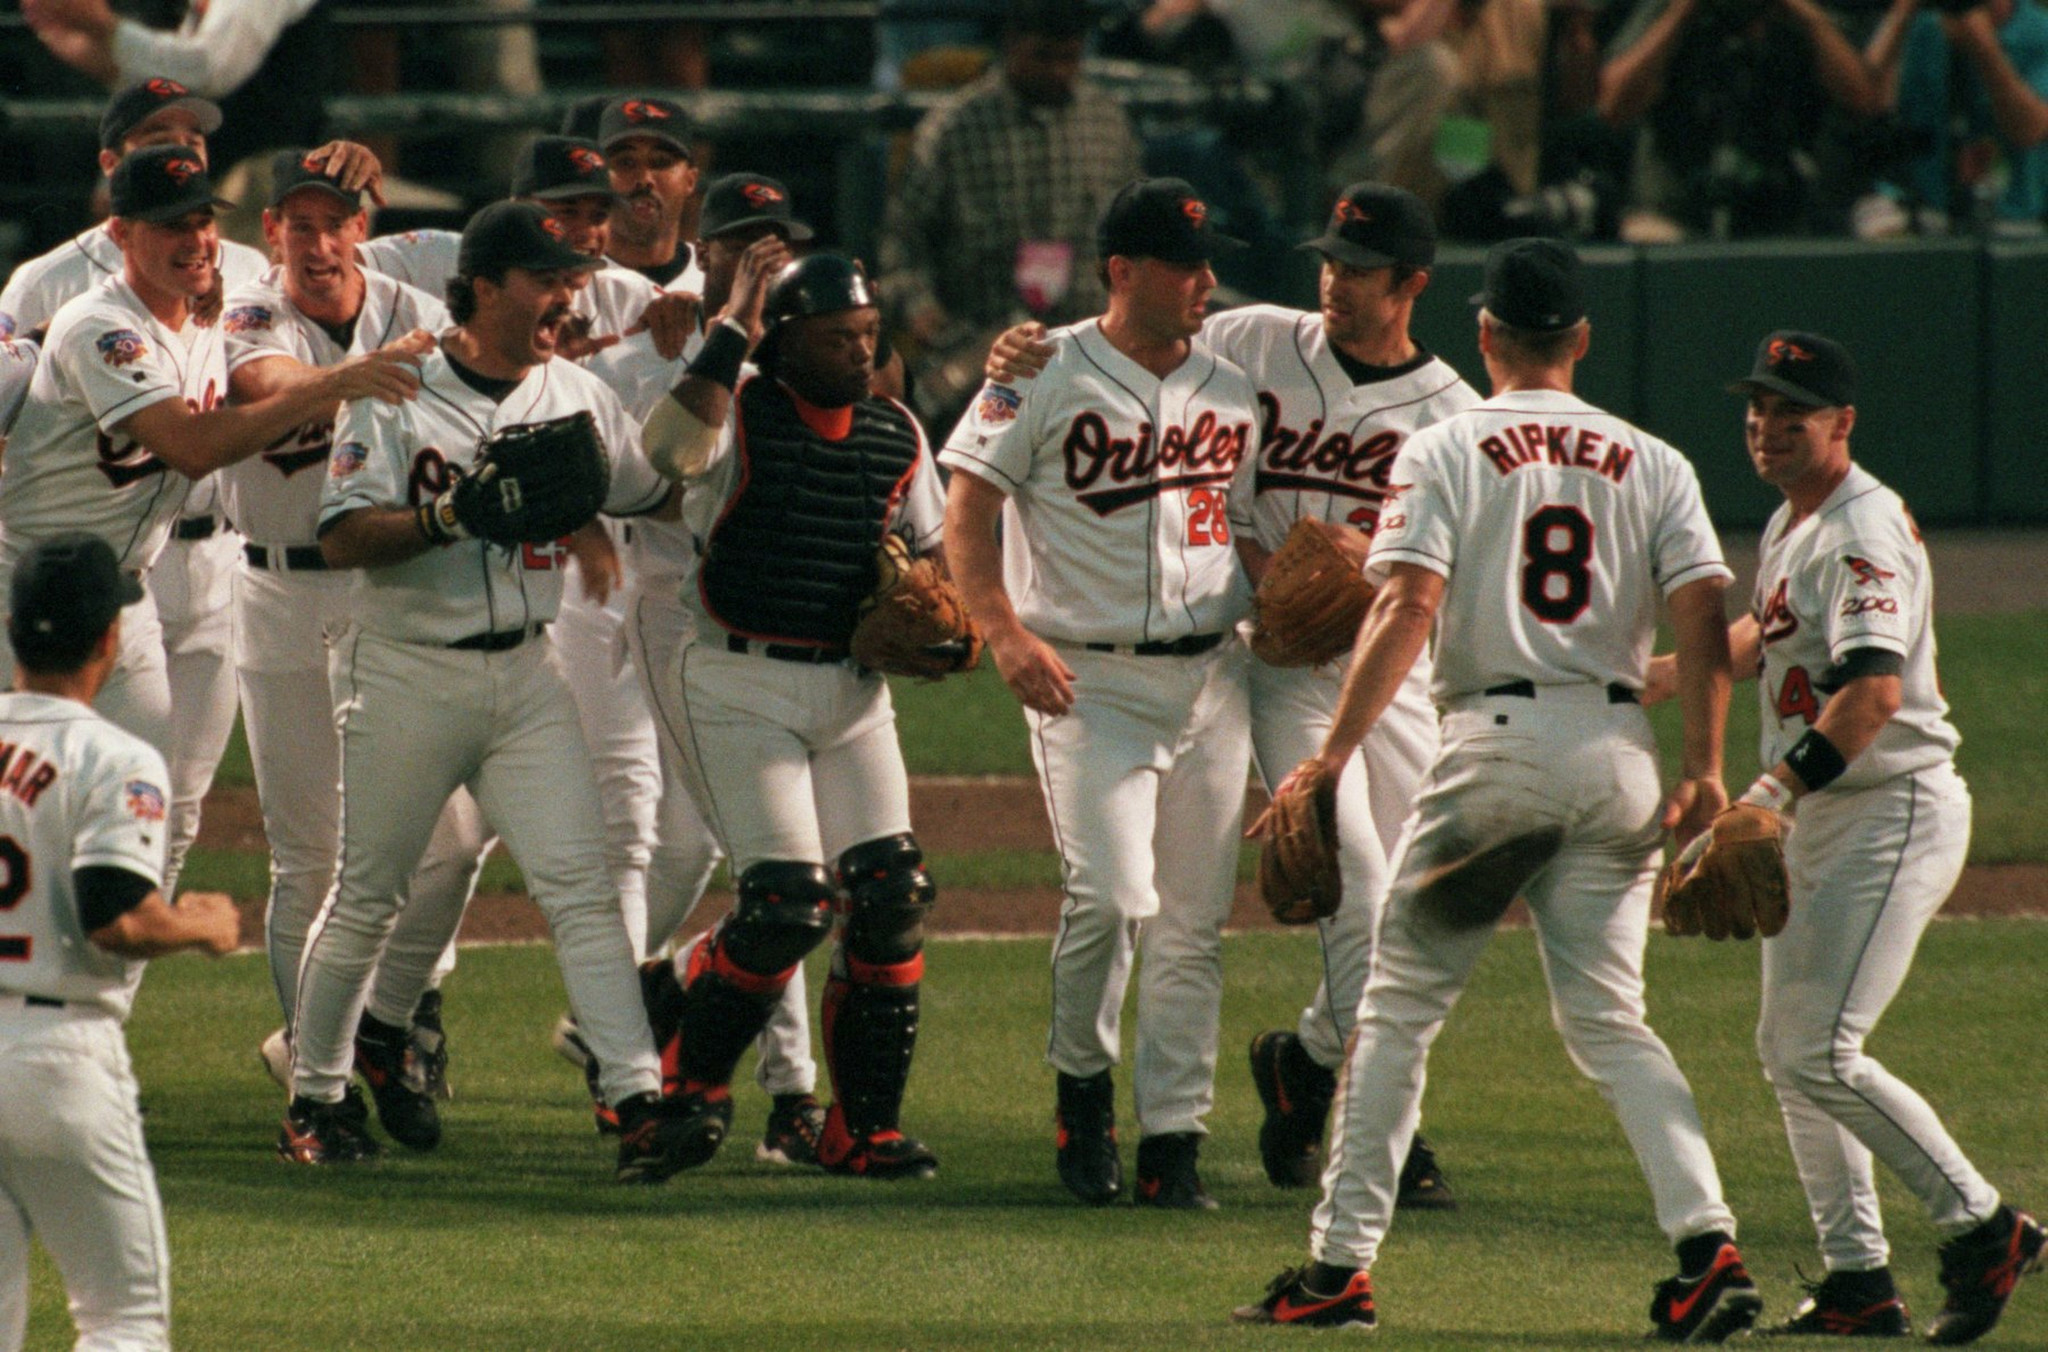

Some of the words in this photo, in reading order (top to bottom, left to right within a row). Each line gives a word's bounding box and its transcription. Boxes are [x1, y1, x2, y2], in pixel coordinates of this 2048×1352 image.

[1063, 410, 1250, 490] Orioles
[1478, 423, 1635, 484] RIPKEN
[1187, 487, 1229, 546] 28
[1521, 504, 1595, 624] 8
[1779, 665, 1820, 726] 4
